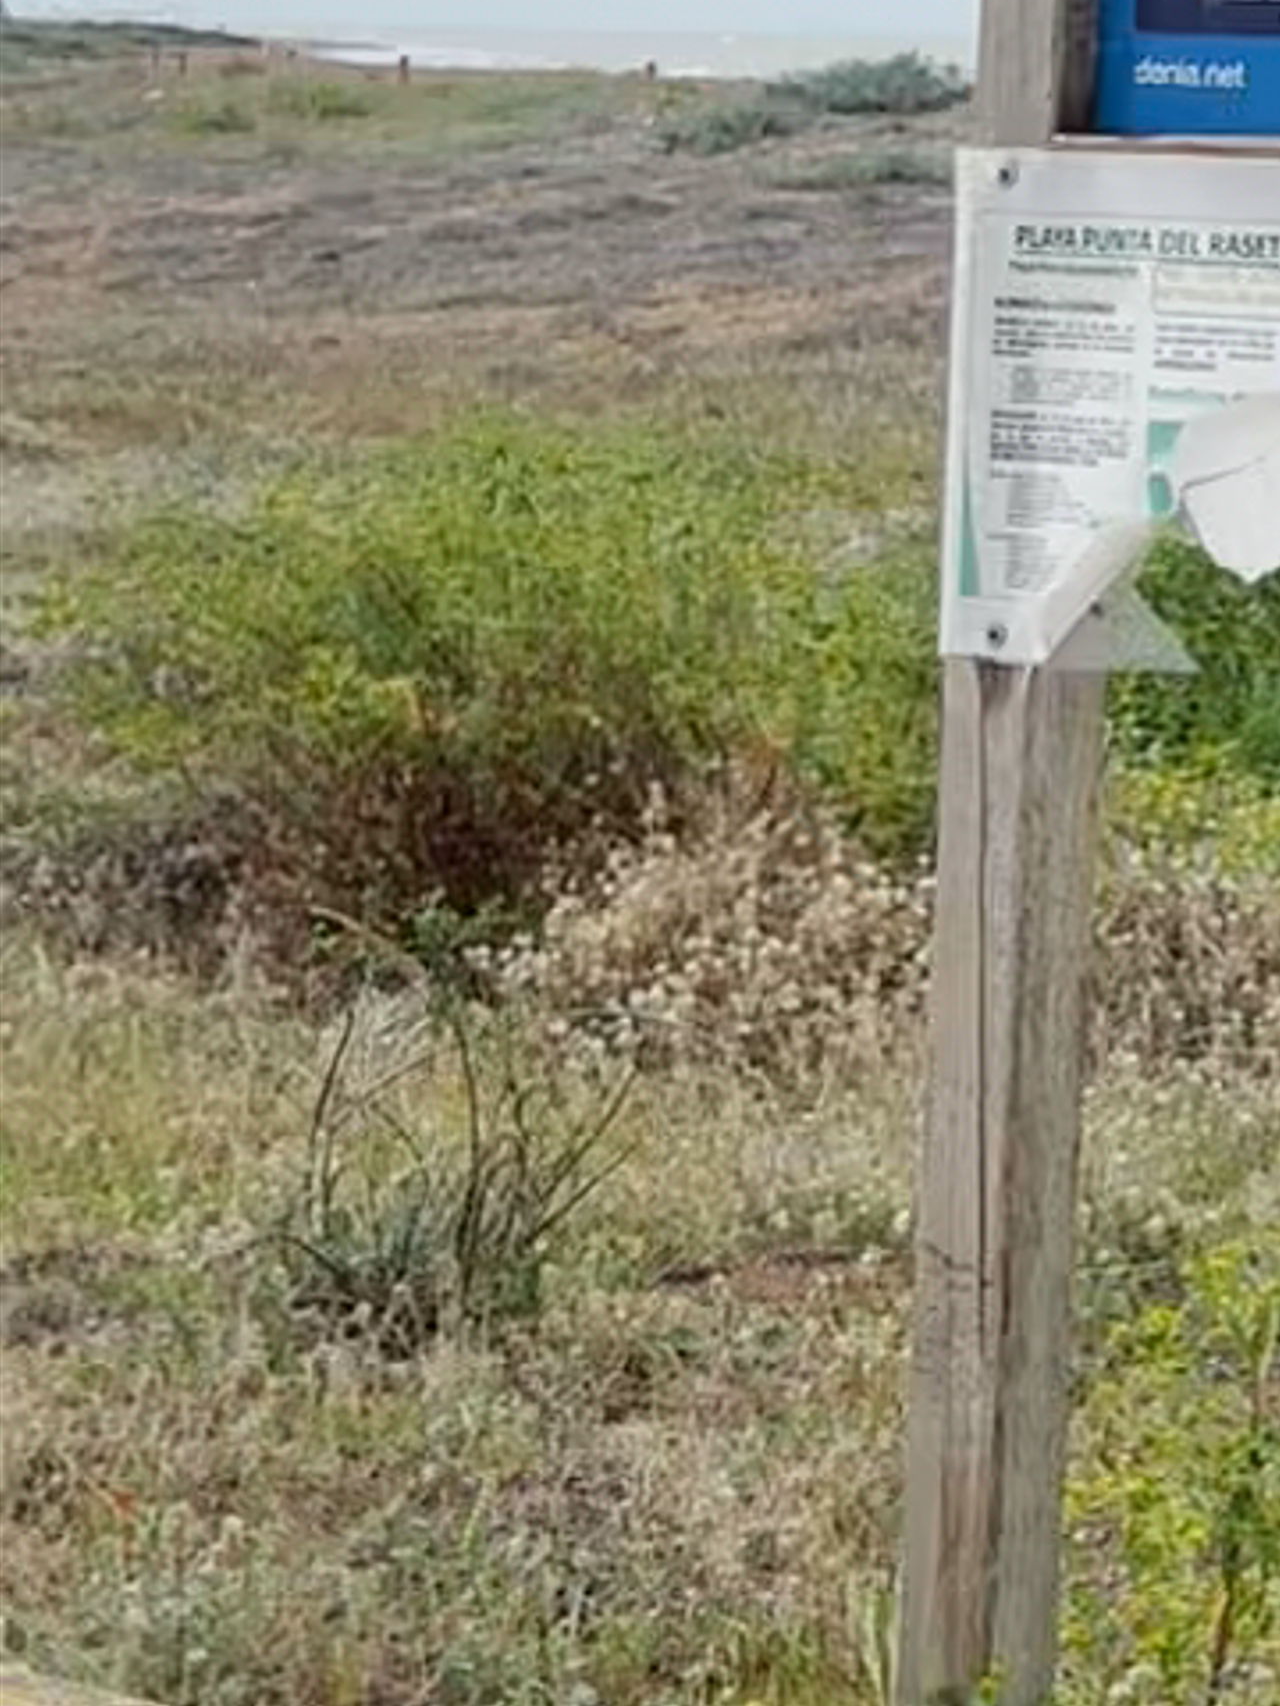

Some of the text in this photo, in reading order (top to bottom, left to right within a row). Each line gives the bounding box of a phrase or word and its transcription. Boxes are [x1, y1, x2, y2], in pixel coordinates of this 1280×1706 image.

[1014, 224, 1280, 260] PLAYA PUNTA DEL RASET
